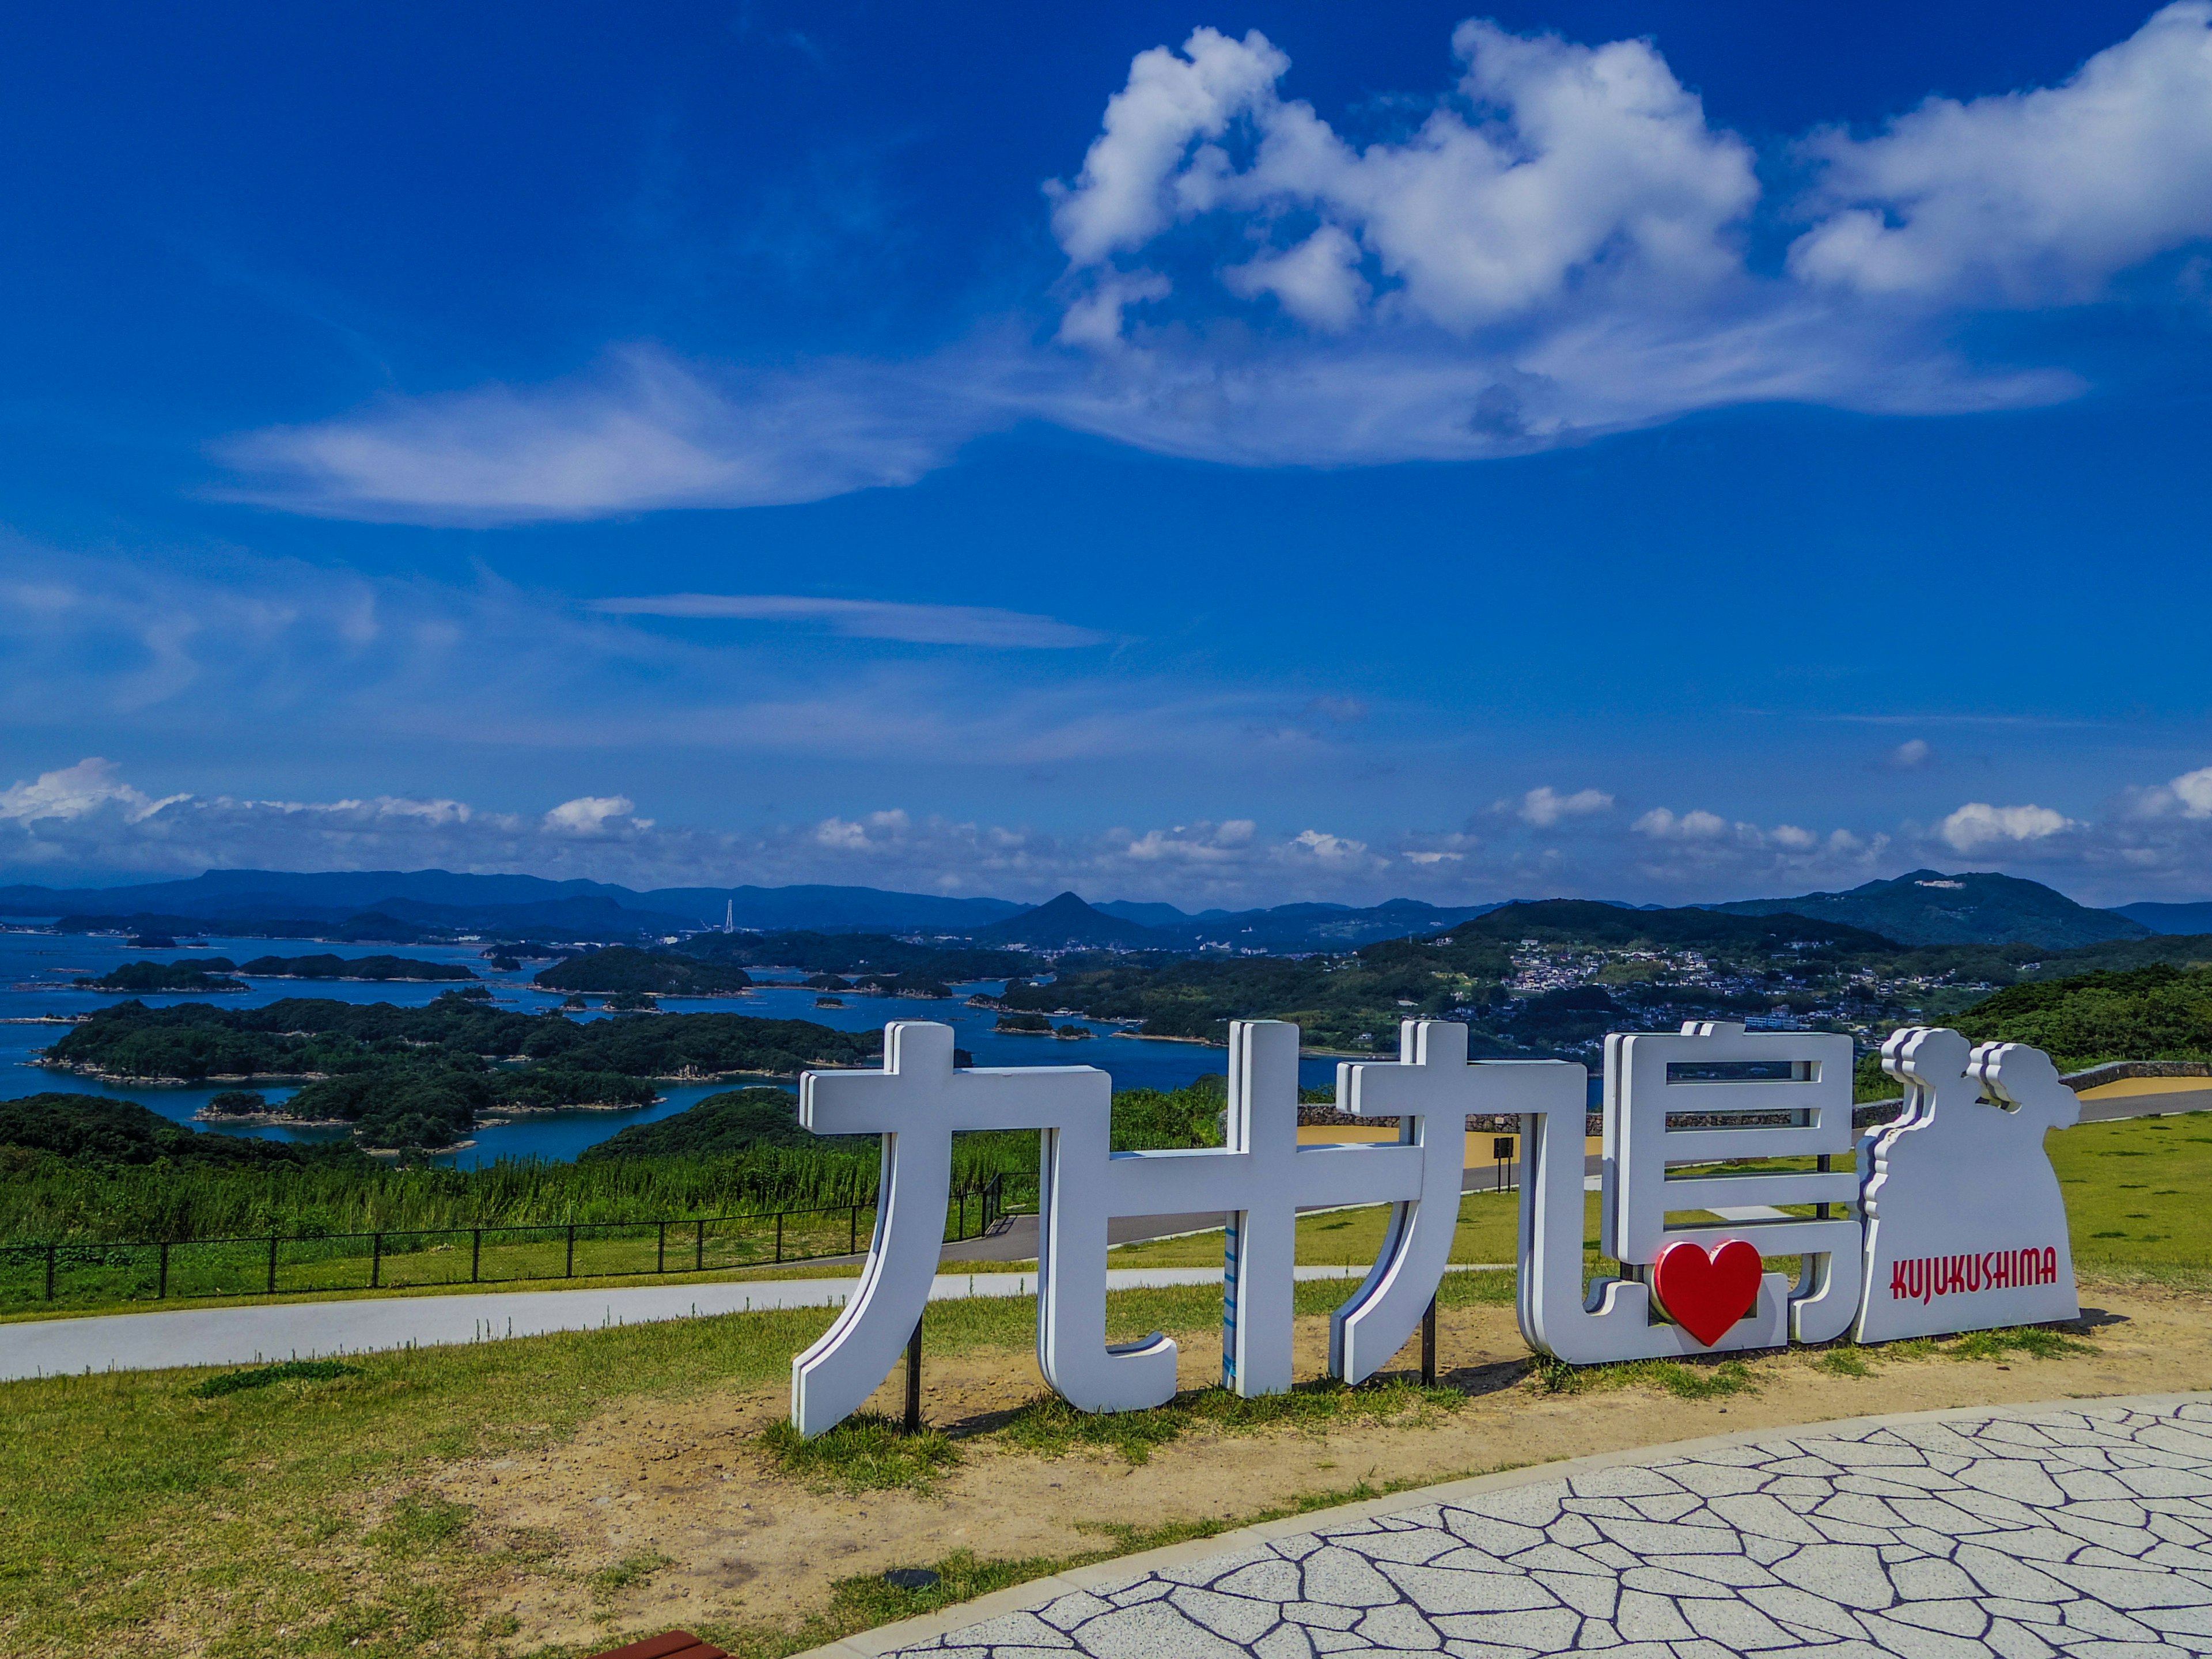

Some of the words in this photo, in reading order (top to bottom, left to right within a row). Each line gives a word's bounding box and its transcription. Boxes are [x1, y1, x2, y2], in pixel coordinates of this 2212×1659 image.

[790, 1020, 1863, 1438] 九十九島
[1889, 1246, 2057, 1306] KUJUKUSHIMA
